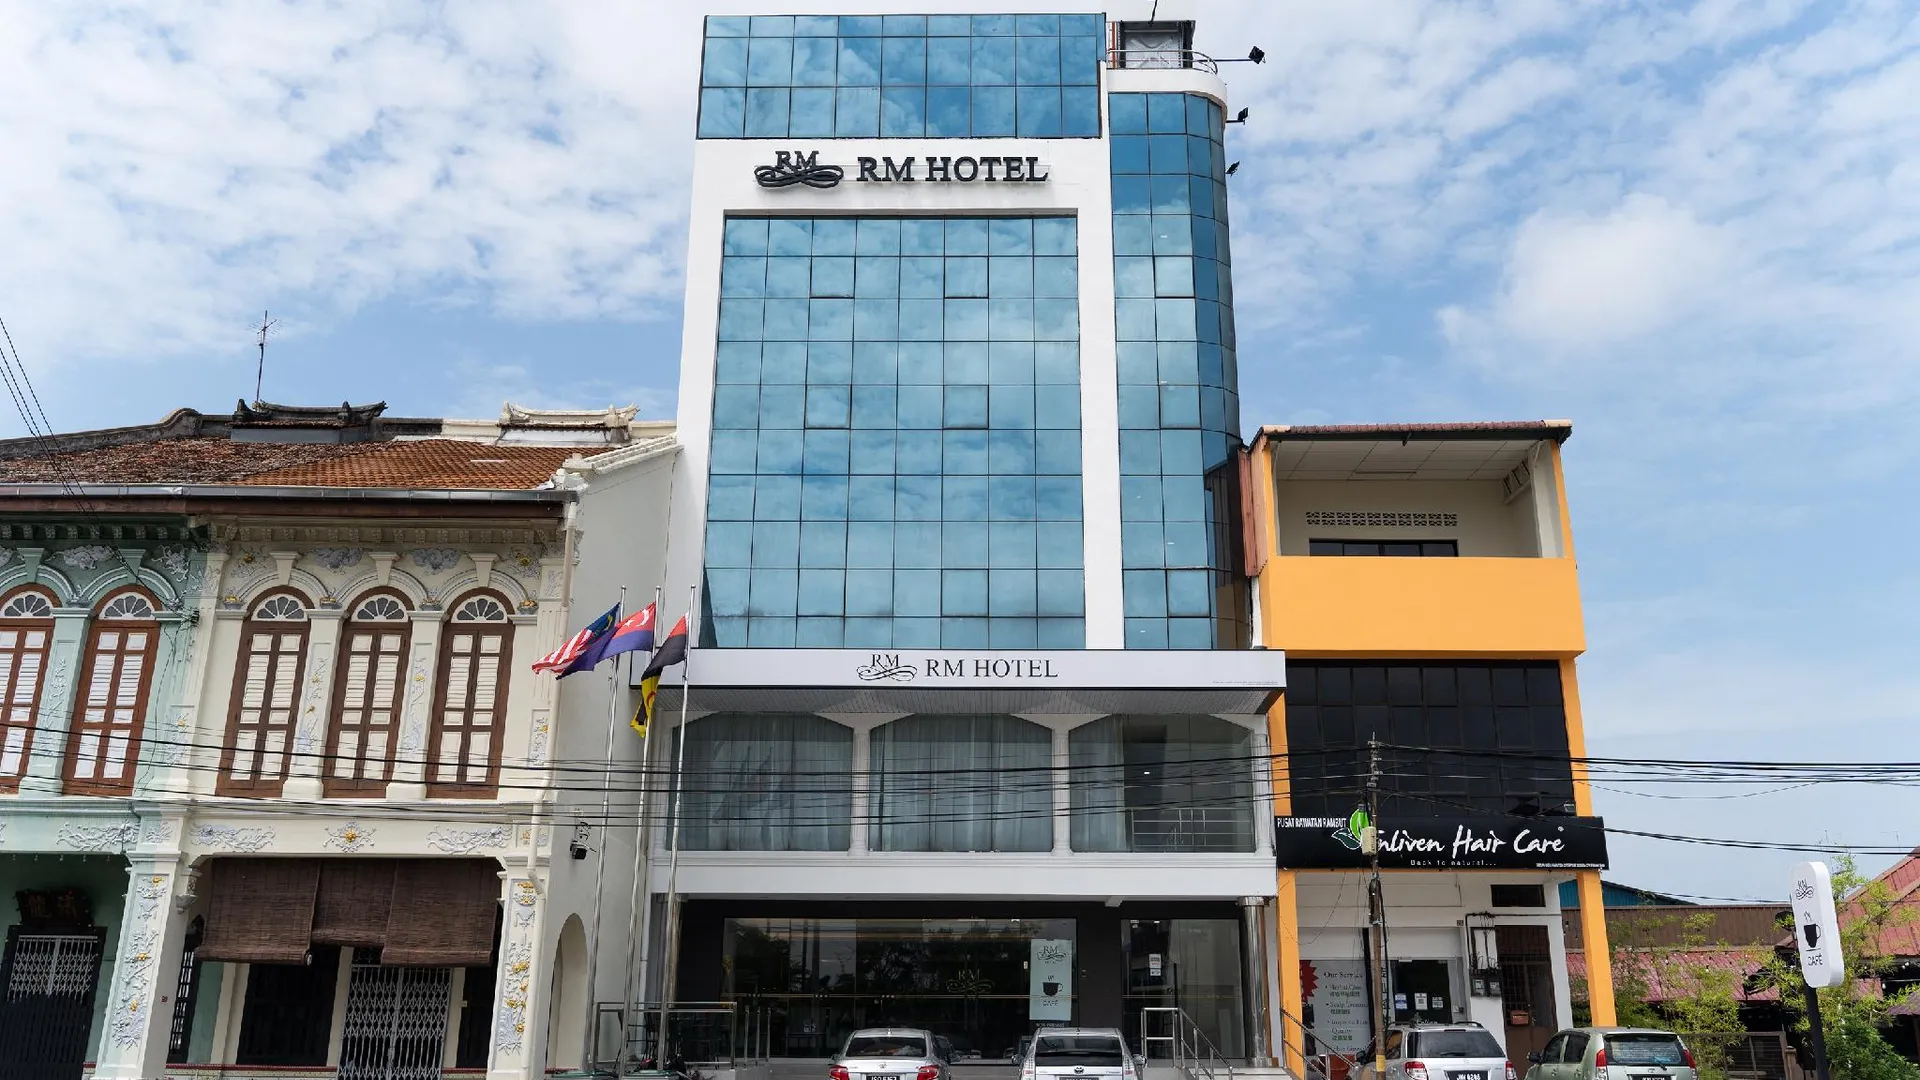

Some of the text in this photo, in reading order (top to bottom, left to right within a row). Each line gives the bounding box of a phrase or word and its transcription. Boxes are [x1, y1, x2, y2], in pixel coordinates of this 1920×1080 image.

[775, 150, 819, 169] RM
[857, 156, 1049, 182] RM HOTEL
[871, 653, 900, 668] RM
[925, 659, 1059, 678] RM HOTEL
[1277, 818, 1347, 828] PUSAT RAWATAN RAMBUT
[1374, 829, 1445, 853] nliven
[1452, 824, 1506, 859] Hair
[1043, 946, 1058, 954] RM
